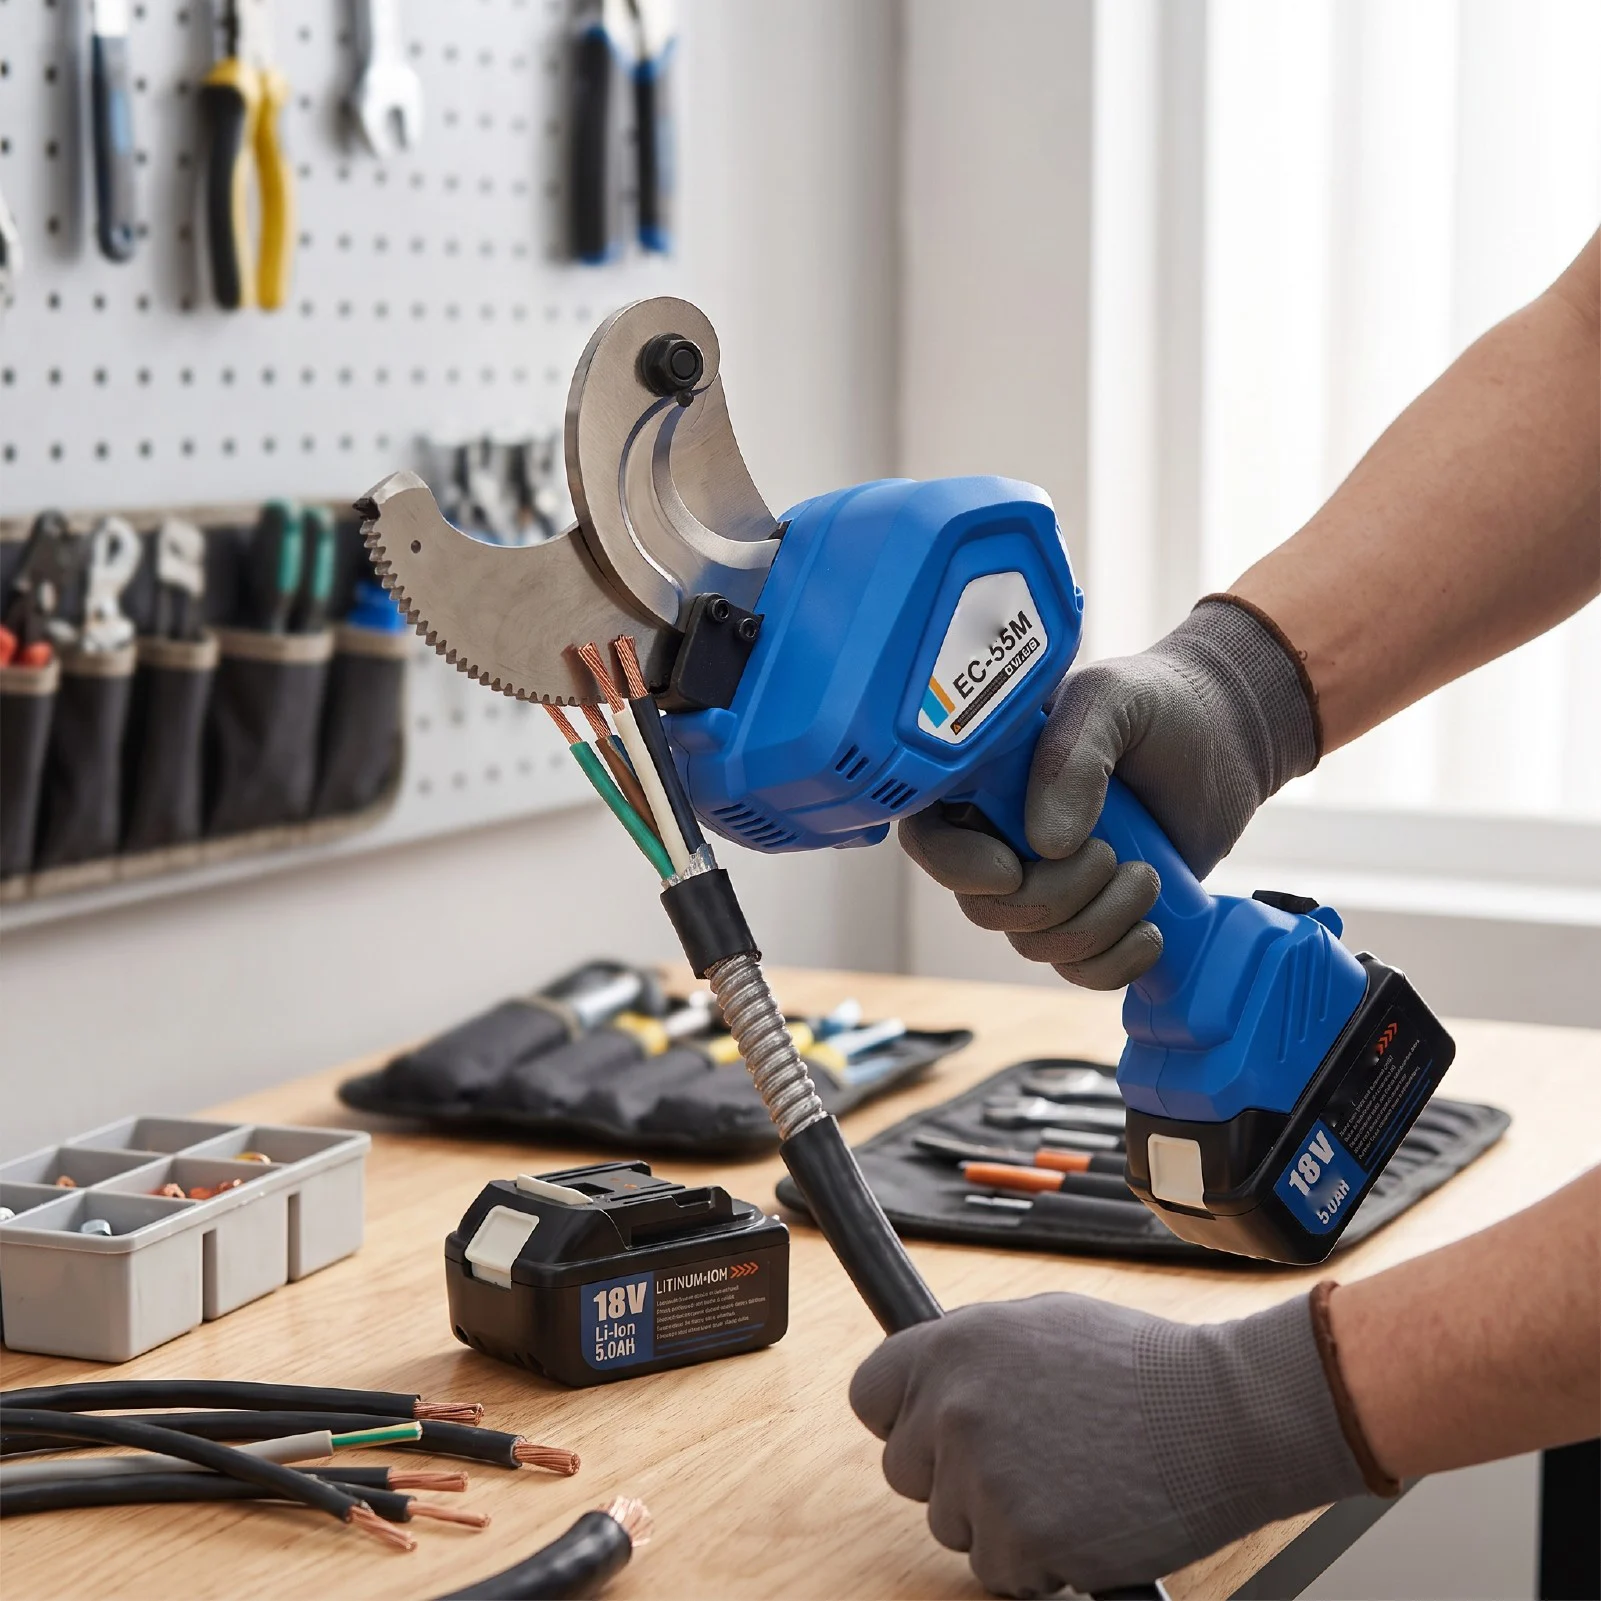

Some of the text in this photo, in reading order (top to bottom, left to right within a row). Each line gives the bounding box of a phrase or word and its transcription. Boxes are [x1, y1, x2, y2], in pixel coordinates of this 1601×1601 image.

[953, 610, 1032, 700] EC-55M
[1289, 1130, 1335, 1197] 18V
[593, 1281, 648, 1322] 18V
[595, 1322, 636, 1343] Li-Ion
[595, 1338, 636, 1362] 5.0AH
